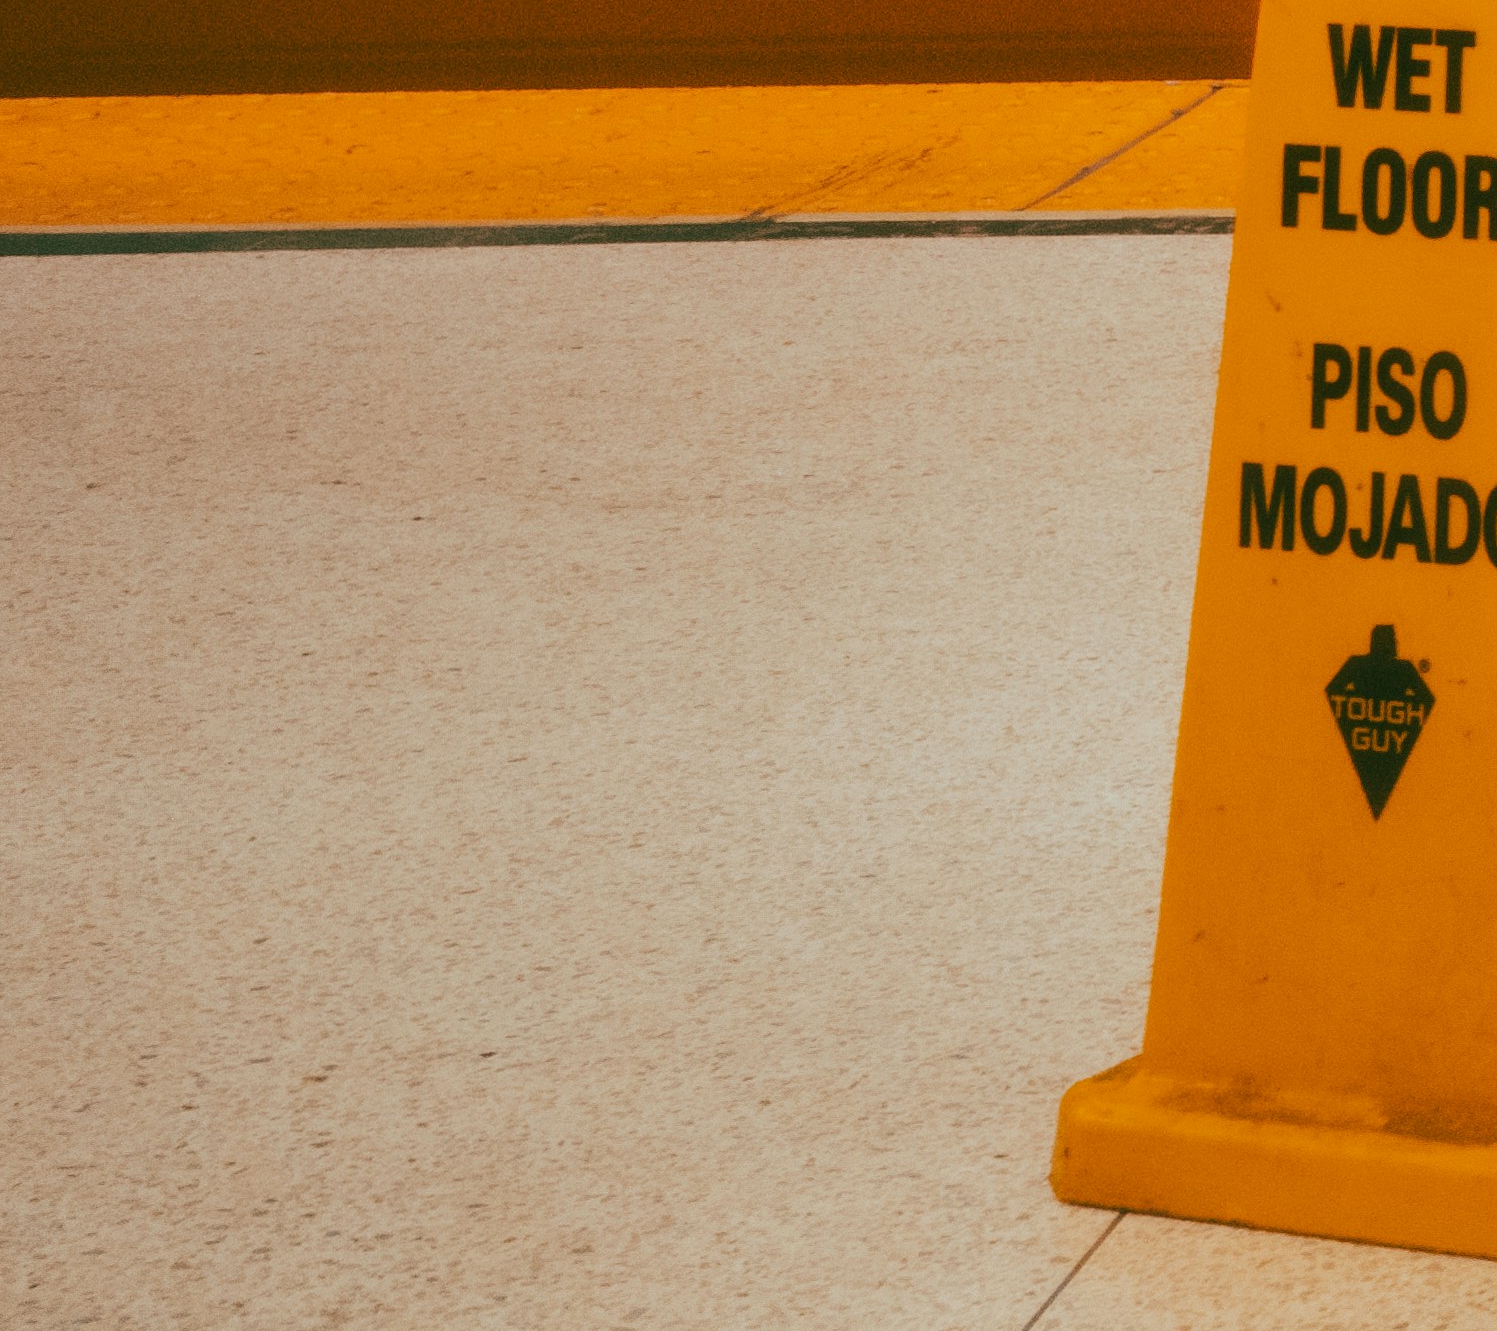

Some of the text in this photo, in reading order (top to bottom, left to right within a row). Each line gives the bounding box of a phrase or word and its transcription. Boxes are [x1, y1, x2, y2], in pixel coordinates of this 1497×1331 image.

[1328, 23, 1476, 114] WET
[1311, 342, 1468, 441] PISO
[1331, 694, 1425, 725] TOUGH
[1352, 726, 1408, 754] GUY
